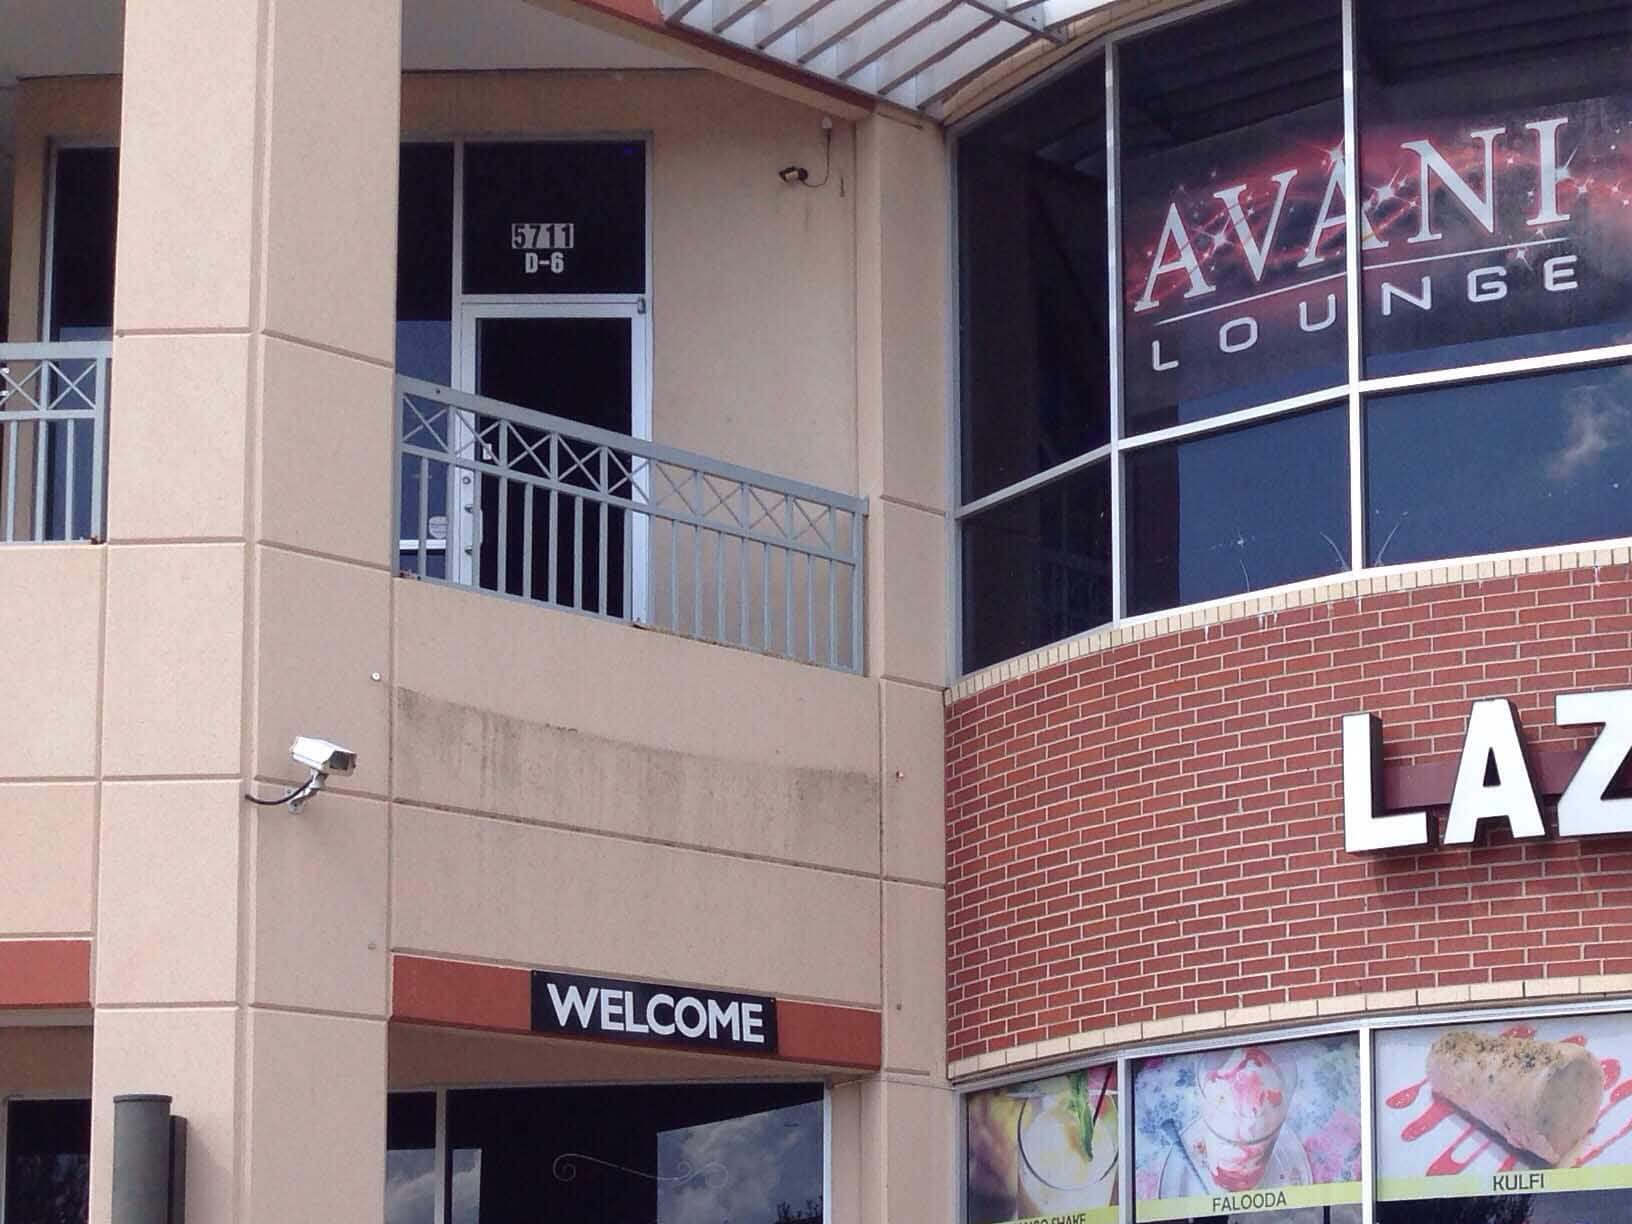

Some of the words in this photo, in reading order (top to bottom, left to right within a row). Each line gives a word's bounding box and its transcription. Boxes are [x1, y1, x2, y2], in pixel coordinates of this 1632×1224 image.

[1134, 116, 1570, 312] AVANI
[514, 223, 571, 249] 5711
[525, 251, 565, 274] D-6
[1151, 255, 1578, 372] LOUNGE
[546, 983, 765, 1043] WELCOME
[1493, 1173, 1545, 1191] KULFI
[1212, 1191, 1288, 1212] FALOODA
